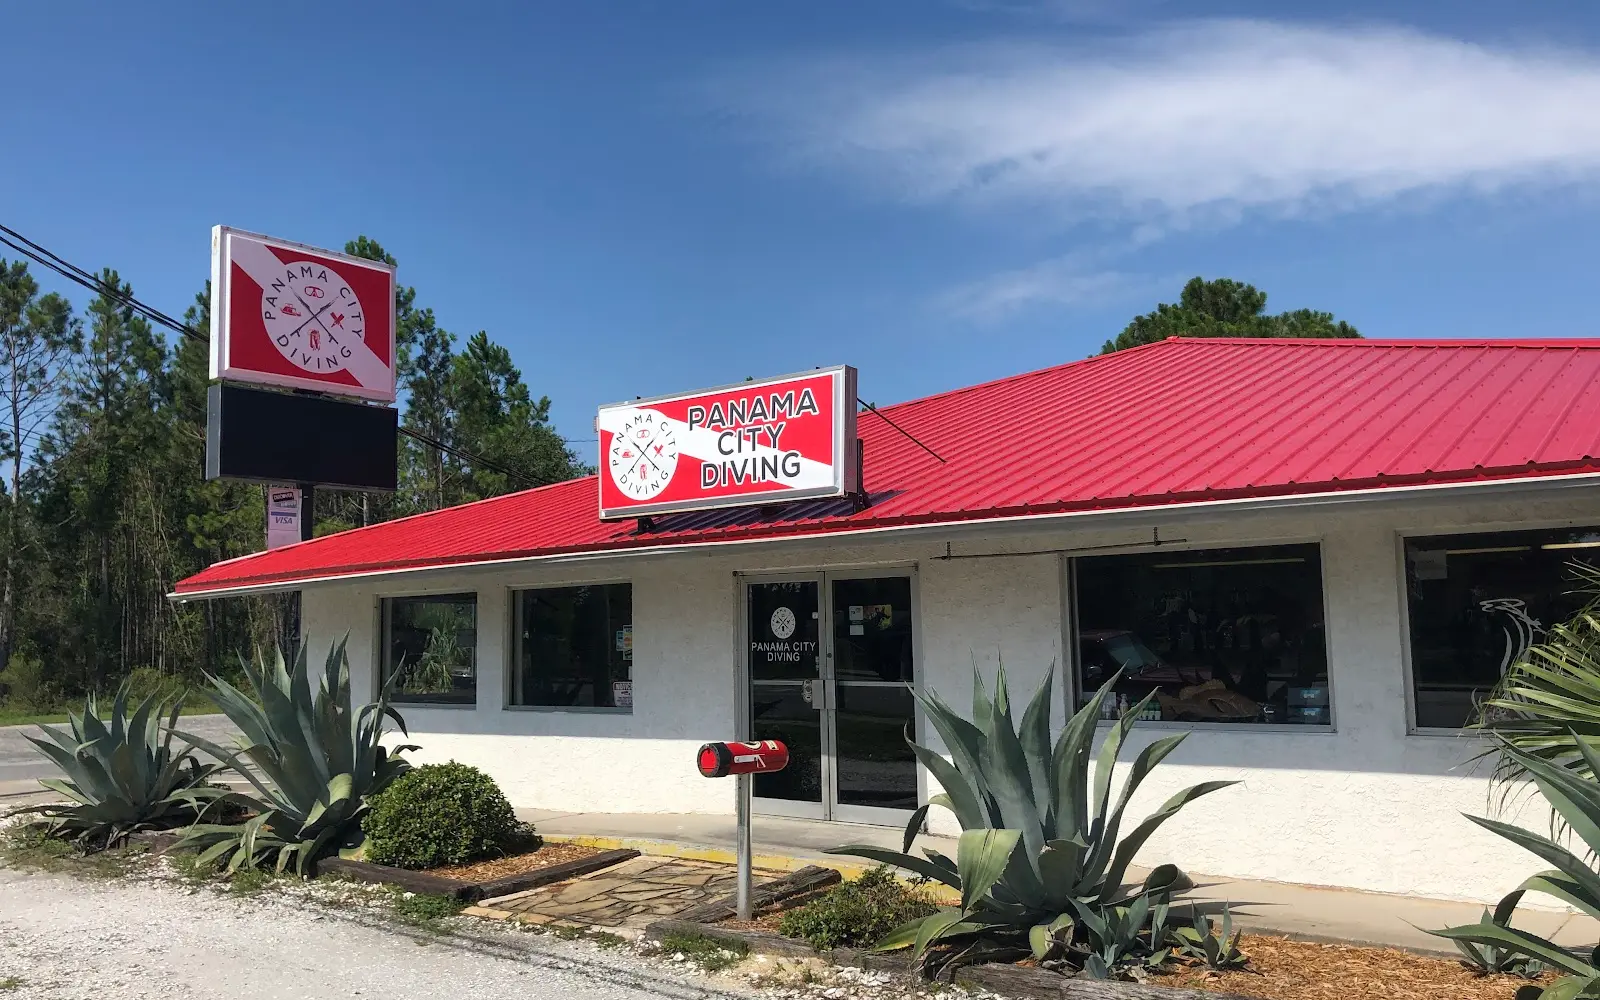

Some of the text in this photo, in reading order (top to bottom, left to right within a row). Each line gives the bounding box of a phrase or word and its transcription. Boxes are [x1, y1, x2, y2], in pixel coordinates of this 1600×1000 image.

[264, 266, 363, 339] PANAMA CITY
[276, 334, 352, 369] DIVING
[688, 389, 818, 431] PANAMA
[612, 413, 677, 467] PANAMA CITY
[717, 423, 785, 456] CITY
[619, 470, 669, 495] DIVING
[702, 452, 801, 488] DIVING
[275, 516, 293, 525] VISA
[751, 641, 816, 652] PANAMA CITY
[767, 652, 800, 662] DIVING
